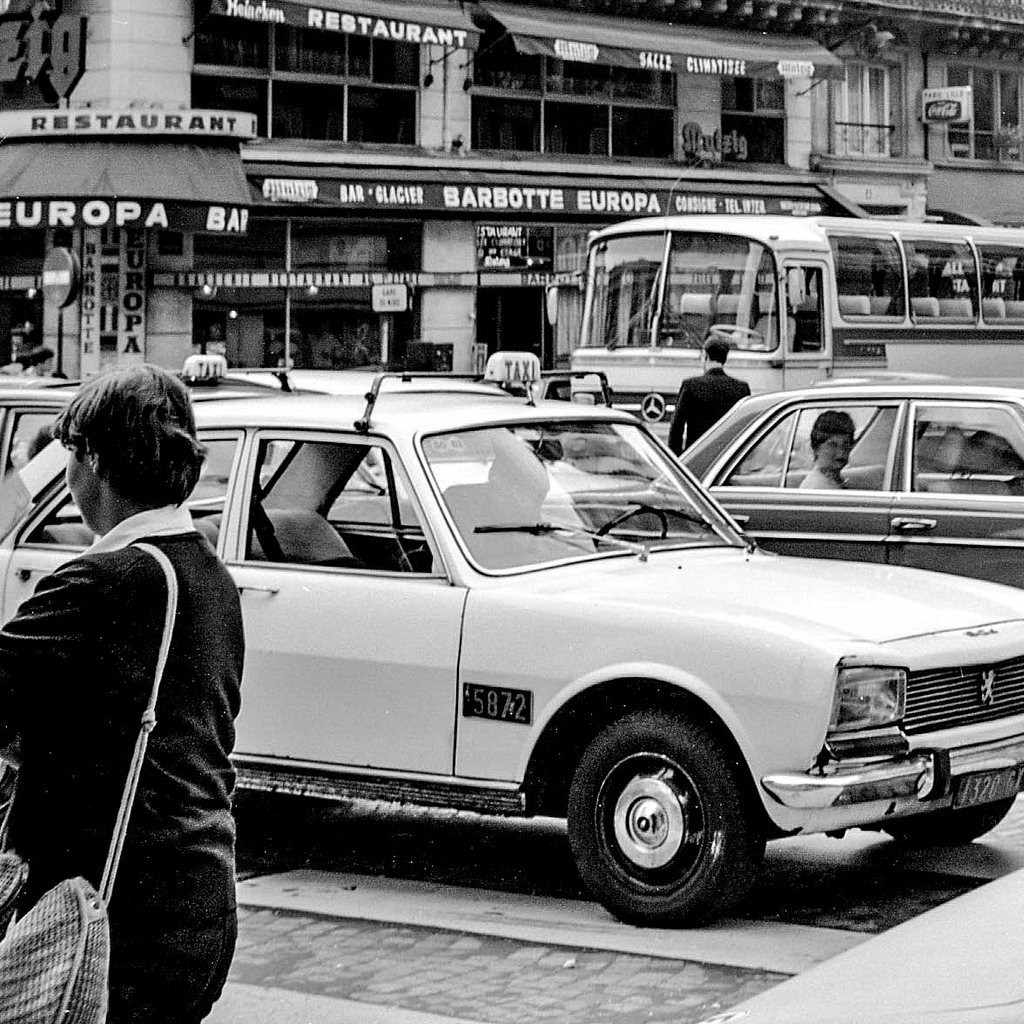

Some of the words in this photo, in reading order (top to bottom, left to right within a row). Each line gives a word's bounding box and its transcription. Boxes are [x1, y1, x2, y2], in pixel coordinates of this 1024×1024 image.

[308, 8, 467, 47] RESTAURANT
[640, 52, 671, 71] SALLE
[31, 115, 237, 132] RESTAURANT
[340, 184, 365, 203] BAR
[375, 185, 423, 204] GLACIER
[443, 185, 564, 210] BARBOTTE
[577, 189, 661, 213] EUROPA
[505, 360, 535, 380] TAXI
[473, 688, 527, 721] 5872
